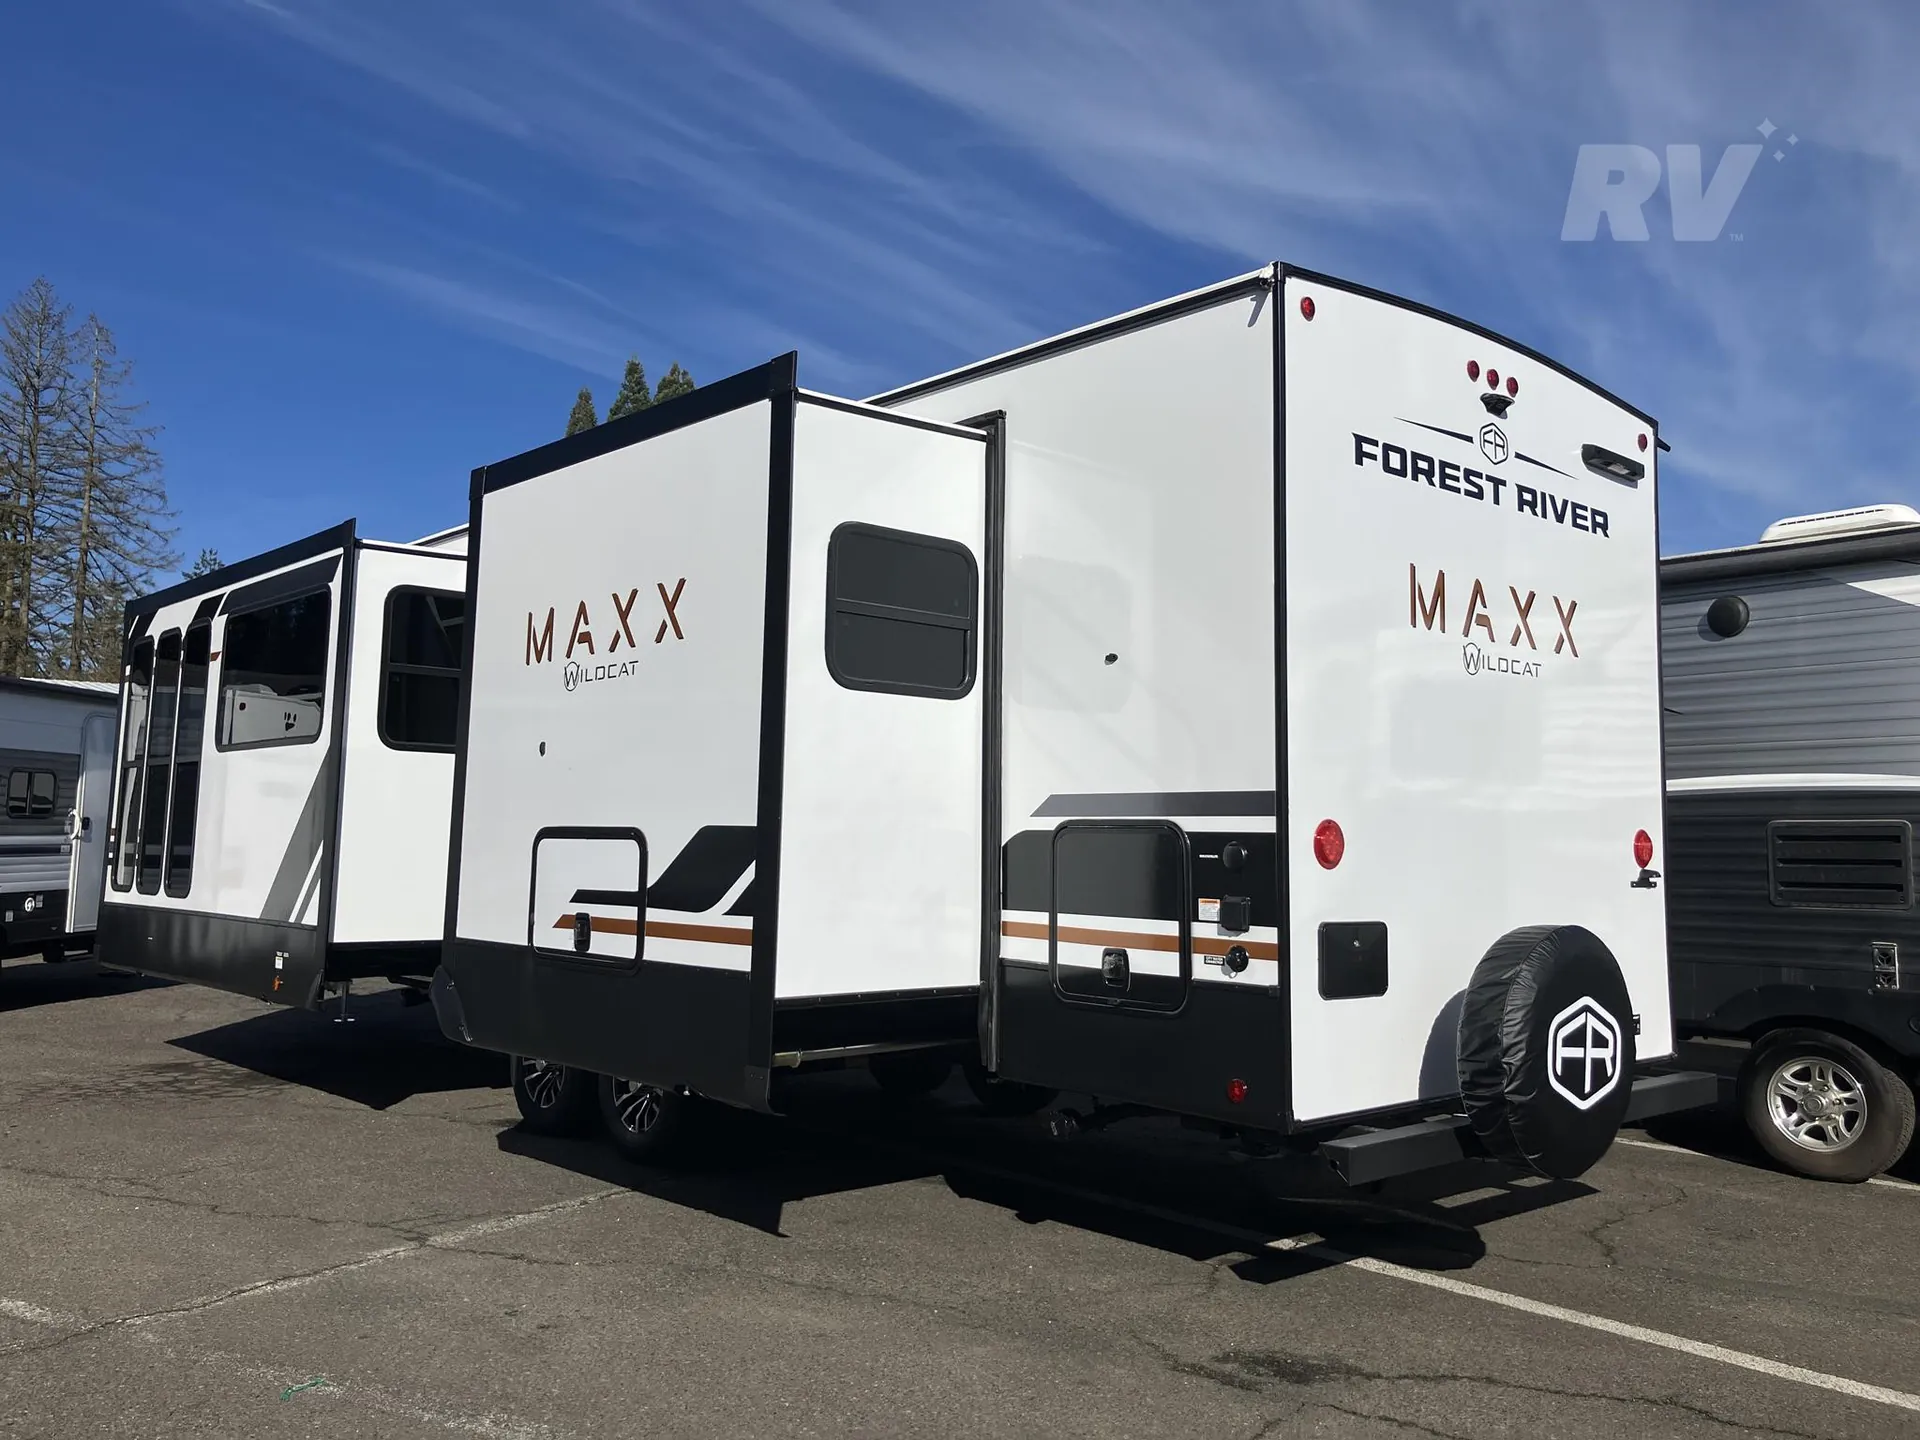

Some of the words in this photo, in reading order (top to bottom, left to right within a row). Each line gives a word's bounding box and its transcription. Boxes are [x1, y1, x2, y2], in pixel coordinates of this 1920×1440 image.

[1351, 432, 1507, 506] FOREST
[1514, 483, 1610, 539] RIVER
[525, 577, 687, 666] MAXX
[1409, 562, 1579, 658] MAXX
